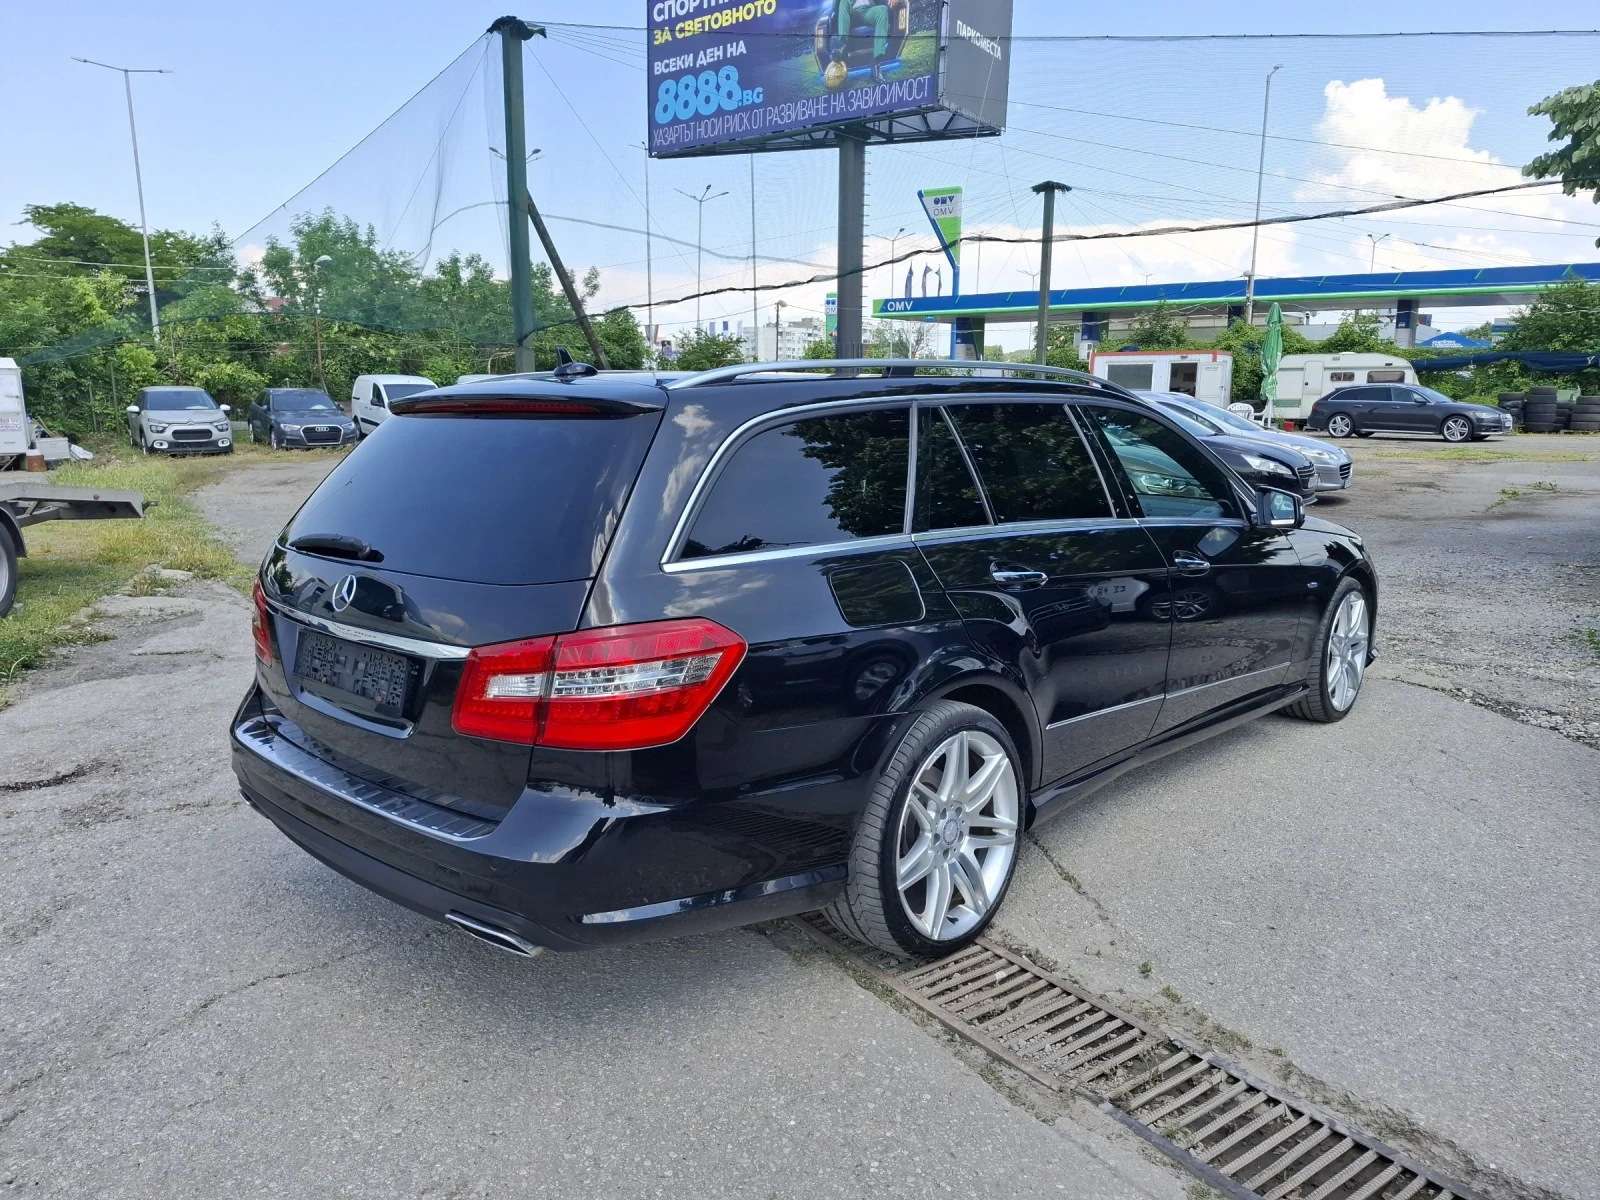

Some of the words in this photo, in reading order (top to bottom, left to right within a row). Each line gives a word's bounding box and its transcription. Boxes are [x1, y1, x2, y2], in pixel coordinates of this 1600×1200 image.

[653, 26, 672, 45] ЗА
[675, 0, 777, 39] СВЕТОВНОТО
[956, 19, 1002, 60] ПАРКОМЕСТА
[654, 53, 693, 75] ВСЕКИ
[696, 45, 723, 68] ДЕН
[727, 40, 747, 58] НА
[653, 122, 695, 147] ХАЗАРТЪТ
[696, 118, 722, 139] НОСИ
[724, 111, 750, 134] РИСК
[751, 108, 765, 129] ОТ
[766, 95, 829, 127] РАЗВИВАНЕ
[830, 92, 845, 114] НА
[847, 75, 931, 111] ЗАВИСИМОСТ
[933, 207, 954, 216] OMV
[887, 300, 913, 311] OMV
